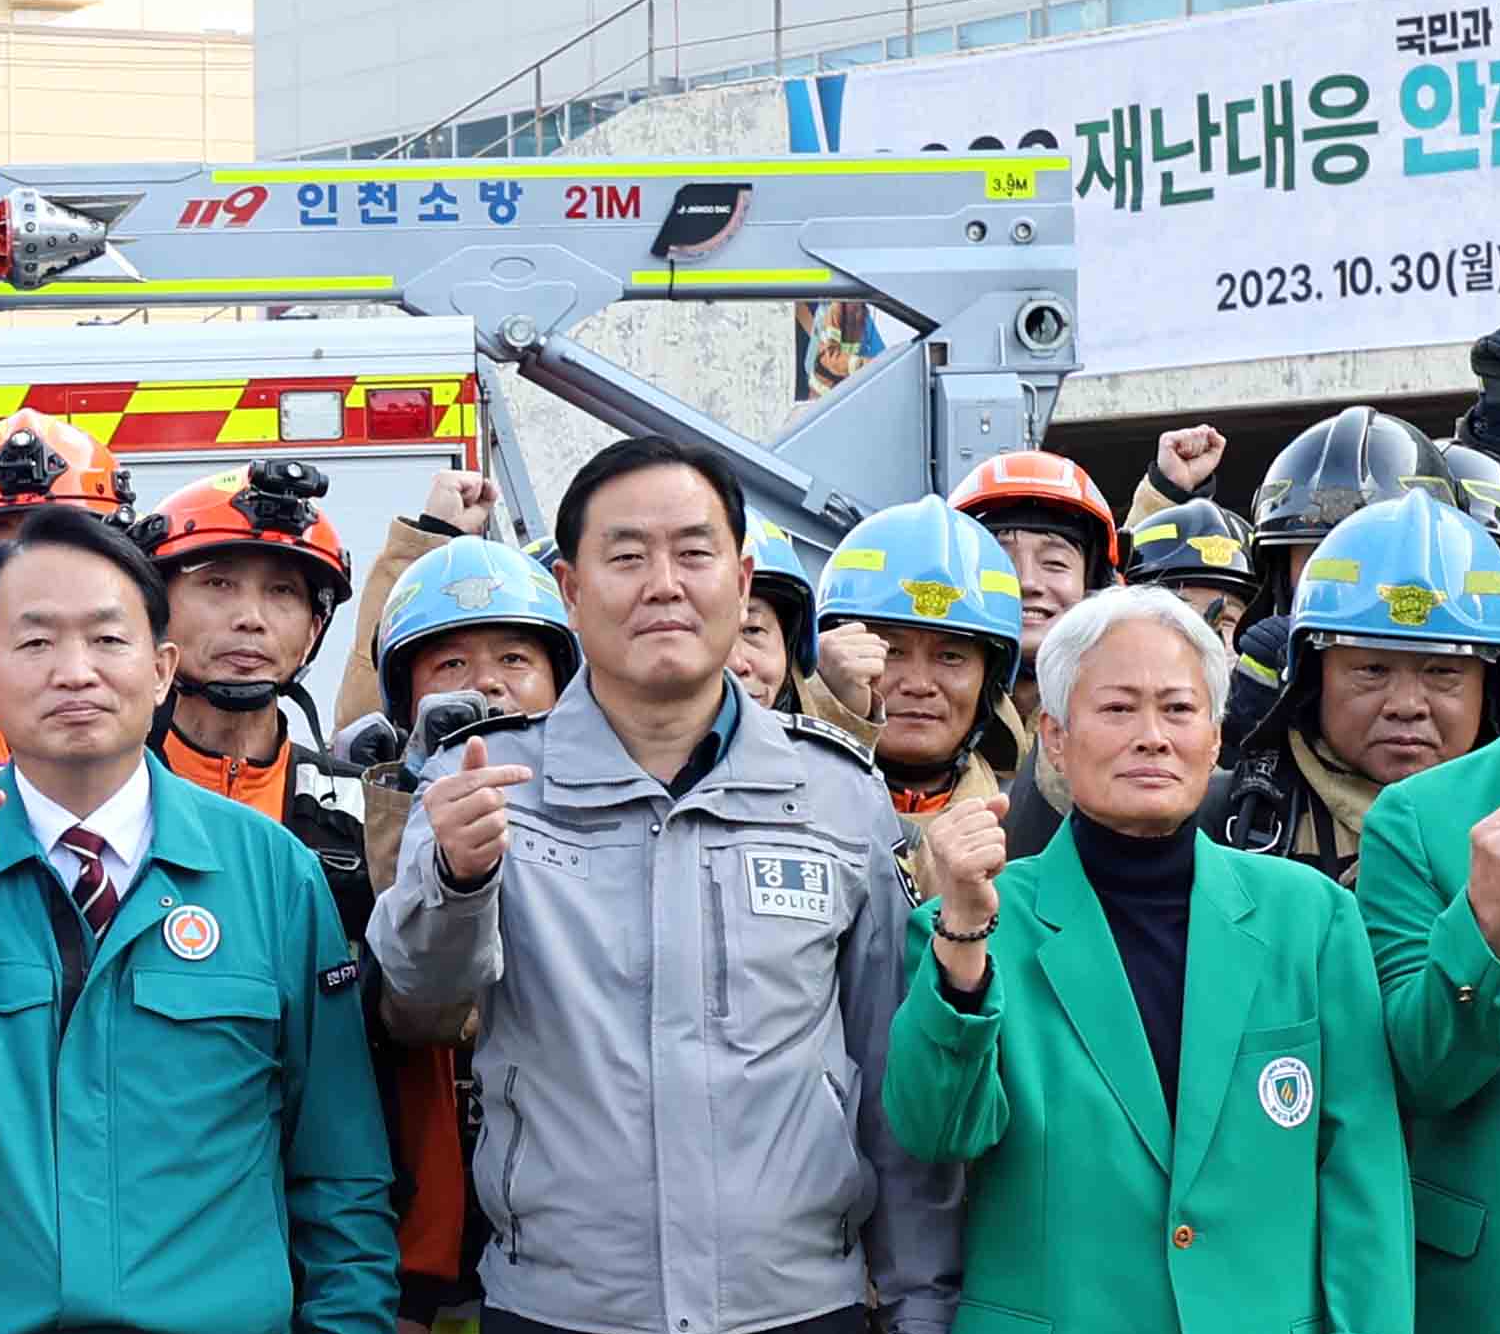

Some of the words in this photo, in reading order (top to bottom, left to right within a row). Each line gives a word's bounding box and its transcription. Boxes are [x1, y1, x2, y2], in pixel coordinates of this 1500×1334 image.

[1396, 10, 1493, 57] 국민과
[1074, 73, 1379, 213] 재난대응
[175, 185, 268, 229] 119
[563, 184, 641, 220] 21M
[761, 893, 825, 913] POLICE
